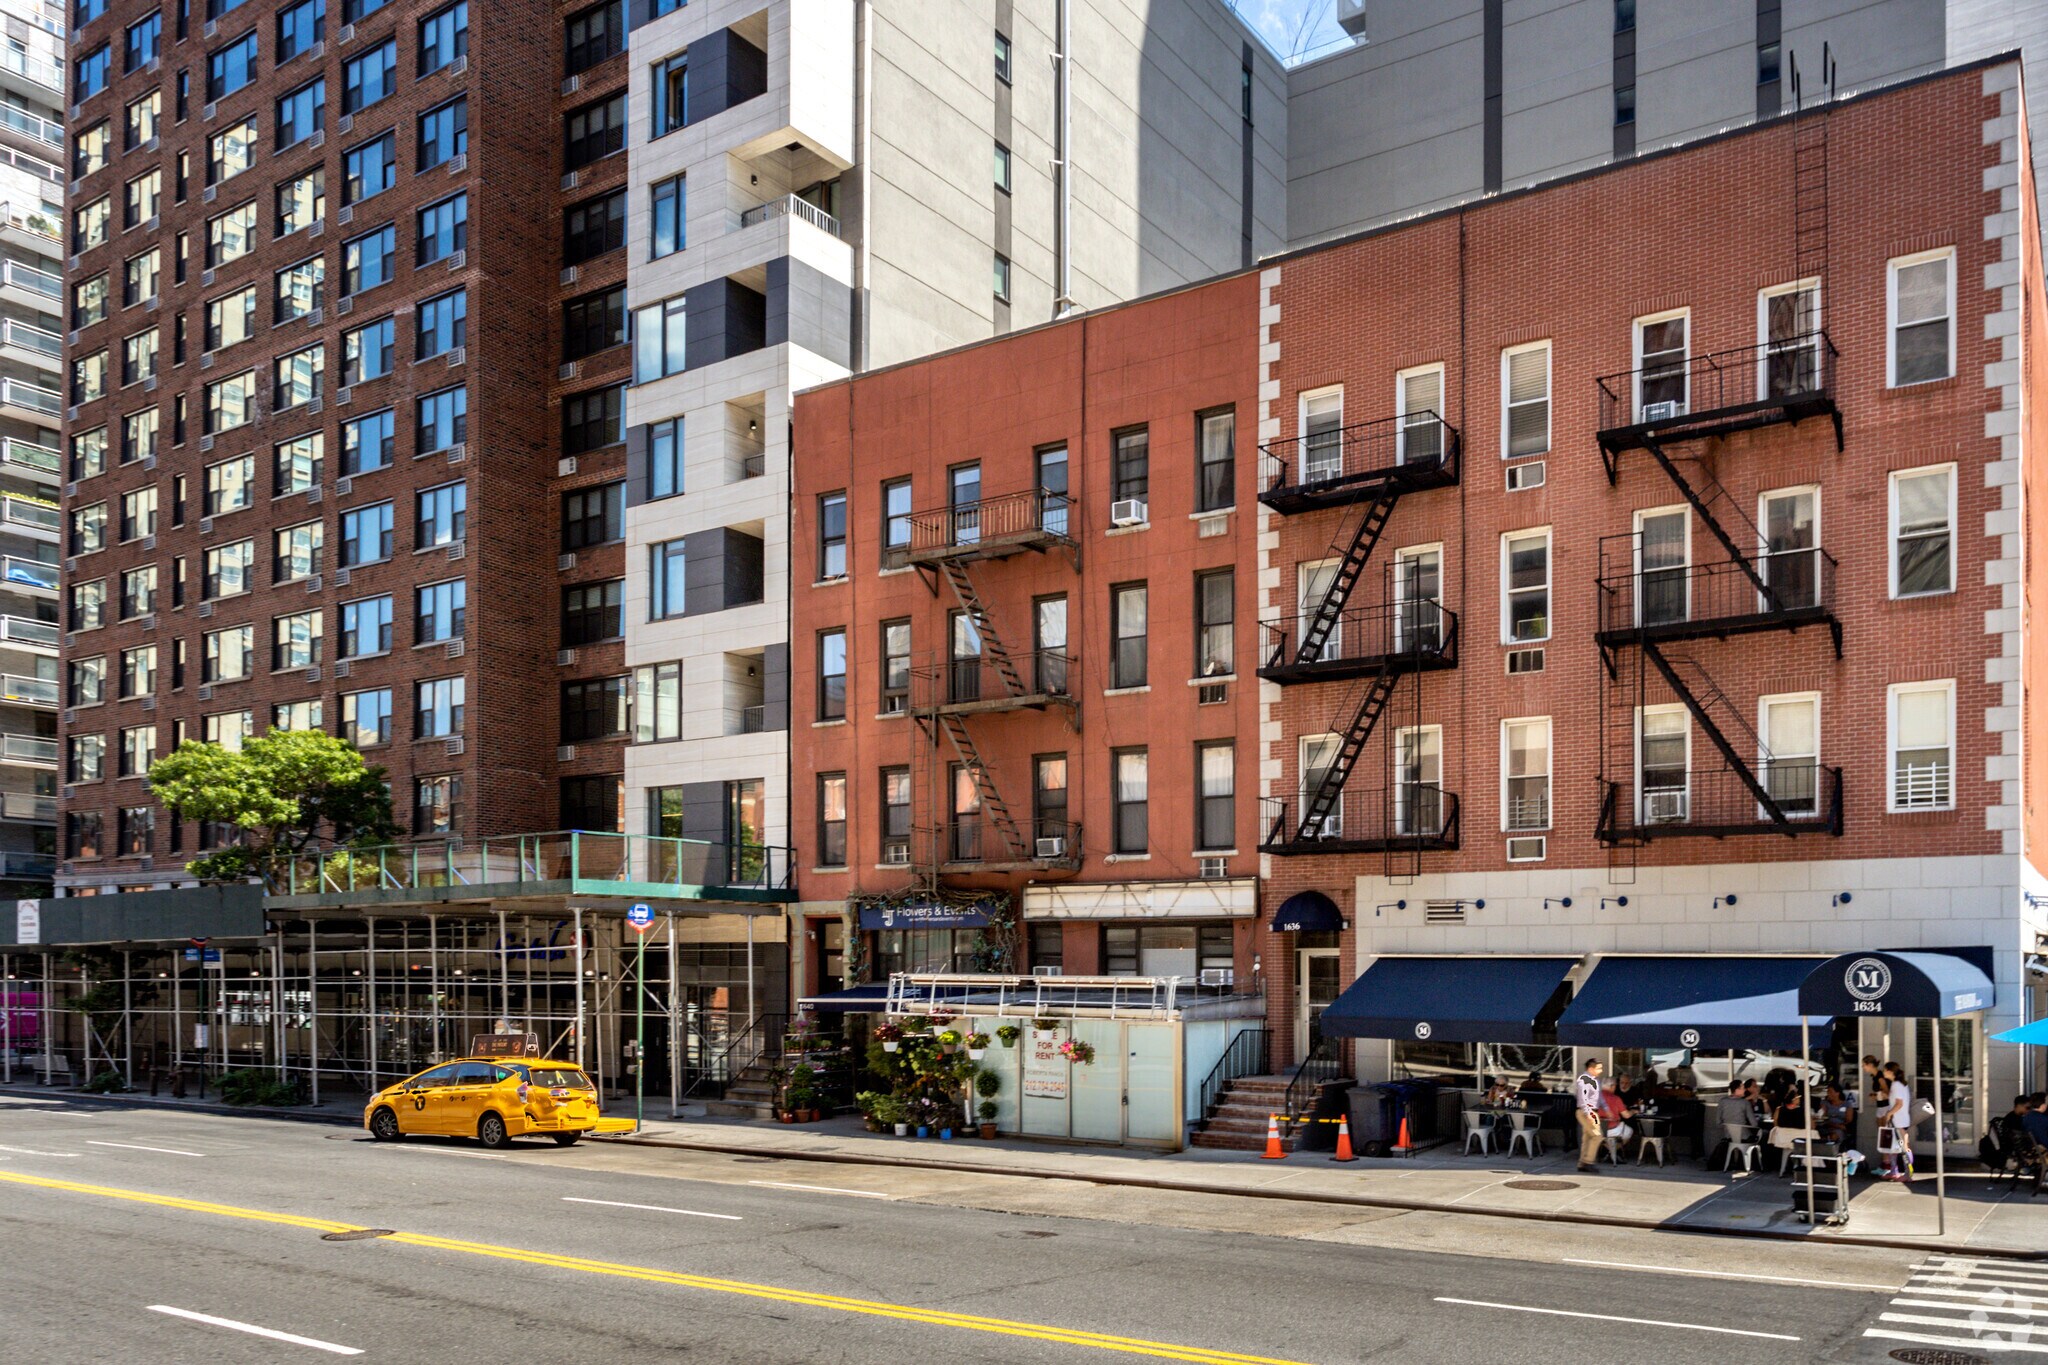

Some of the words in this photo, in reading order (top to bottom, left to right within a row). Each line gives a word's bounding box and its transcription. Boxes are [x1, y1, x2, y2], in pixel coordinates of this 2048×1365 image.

[896, 906, 932, 917] Flowers
[934, 906, 942, 916] &
[1284, 922, 1301, 931] 1636
[1856, 970, 1880, 988] M
[1853, 1001, 1882, 1012] 1634
[1037, 1041, 1053, 1050] FOR
[1035, 1052, 1055, 1061] RENT
